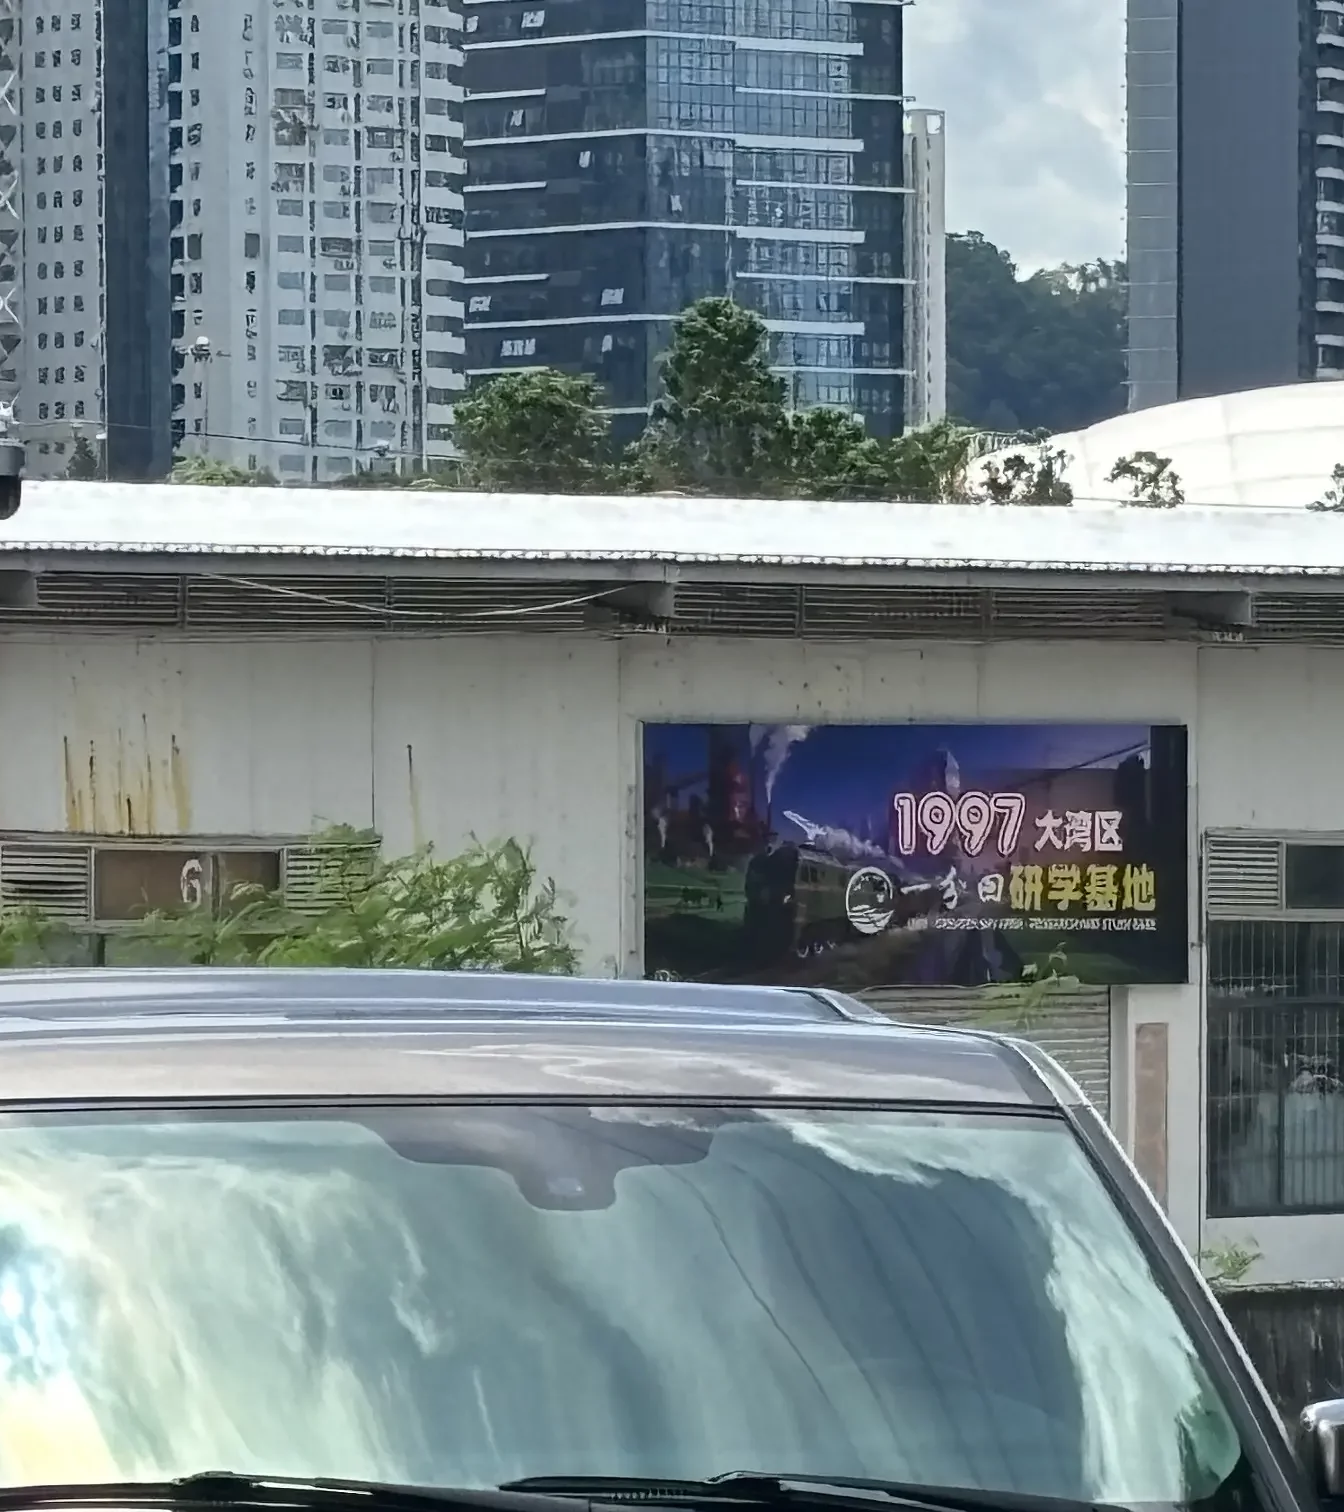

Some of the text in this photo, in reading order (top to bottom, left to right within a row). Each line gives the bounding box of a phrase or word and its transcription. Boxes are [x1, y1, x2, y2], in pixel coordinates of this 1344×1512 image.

[894, 791, 1124, 857] 1997 大湾区
